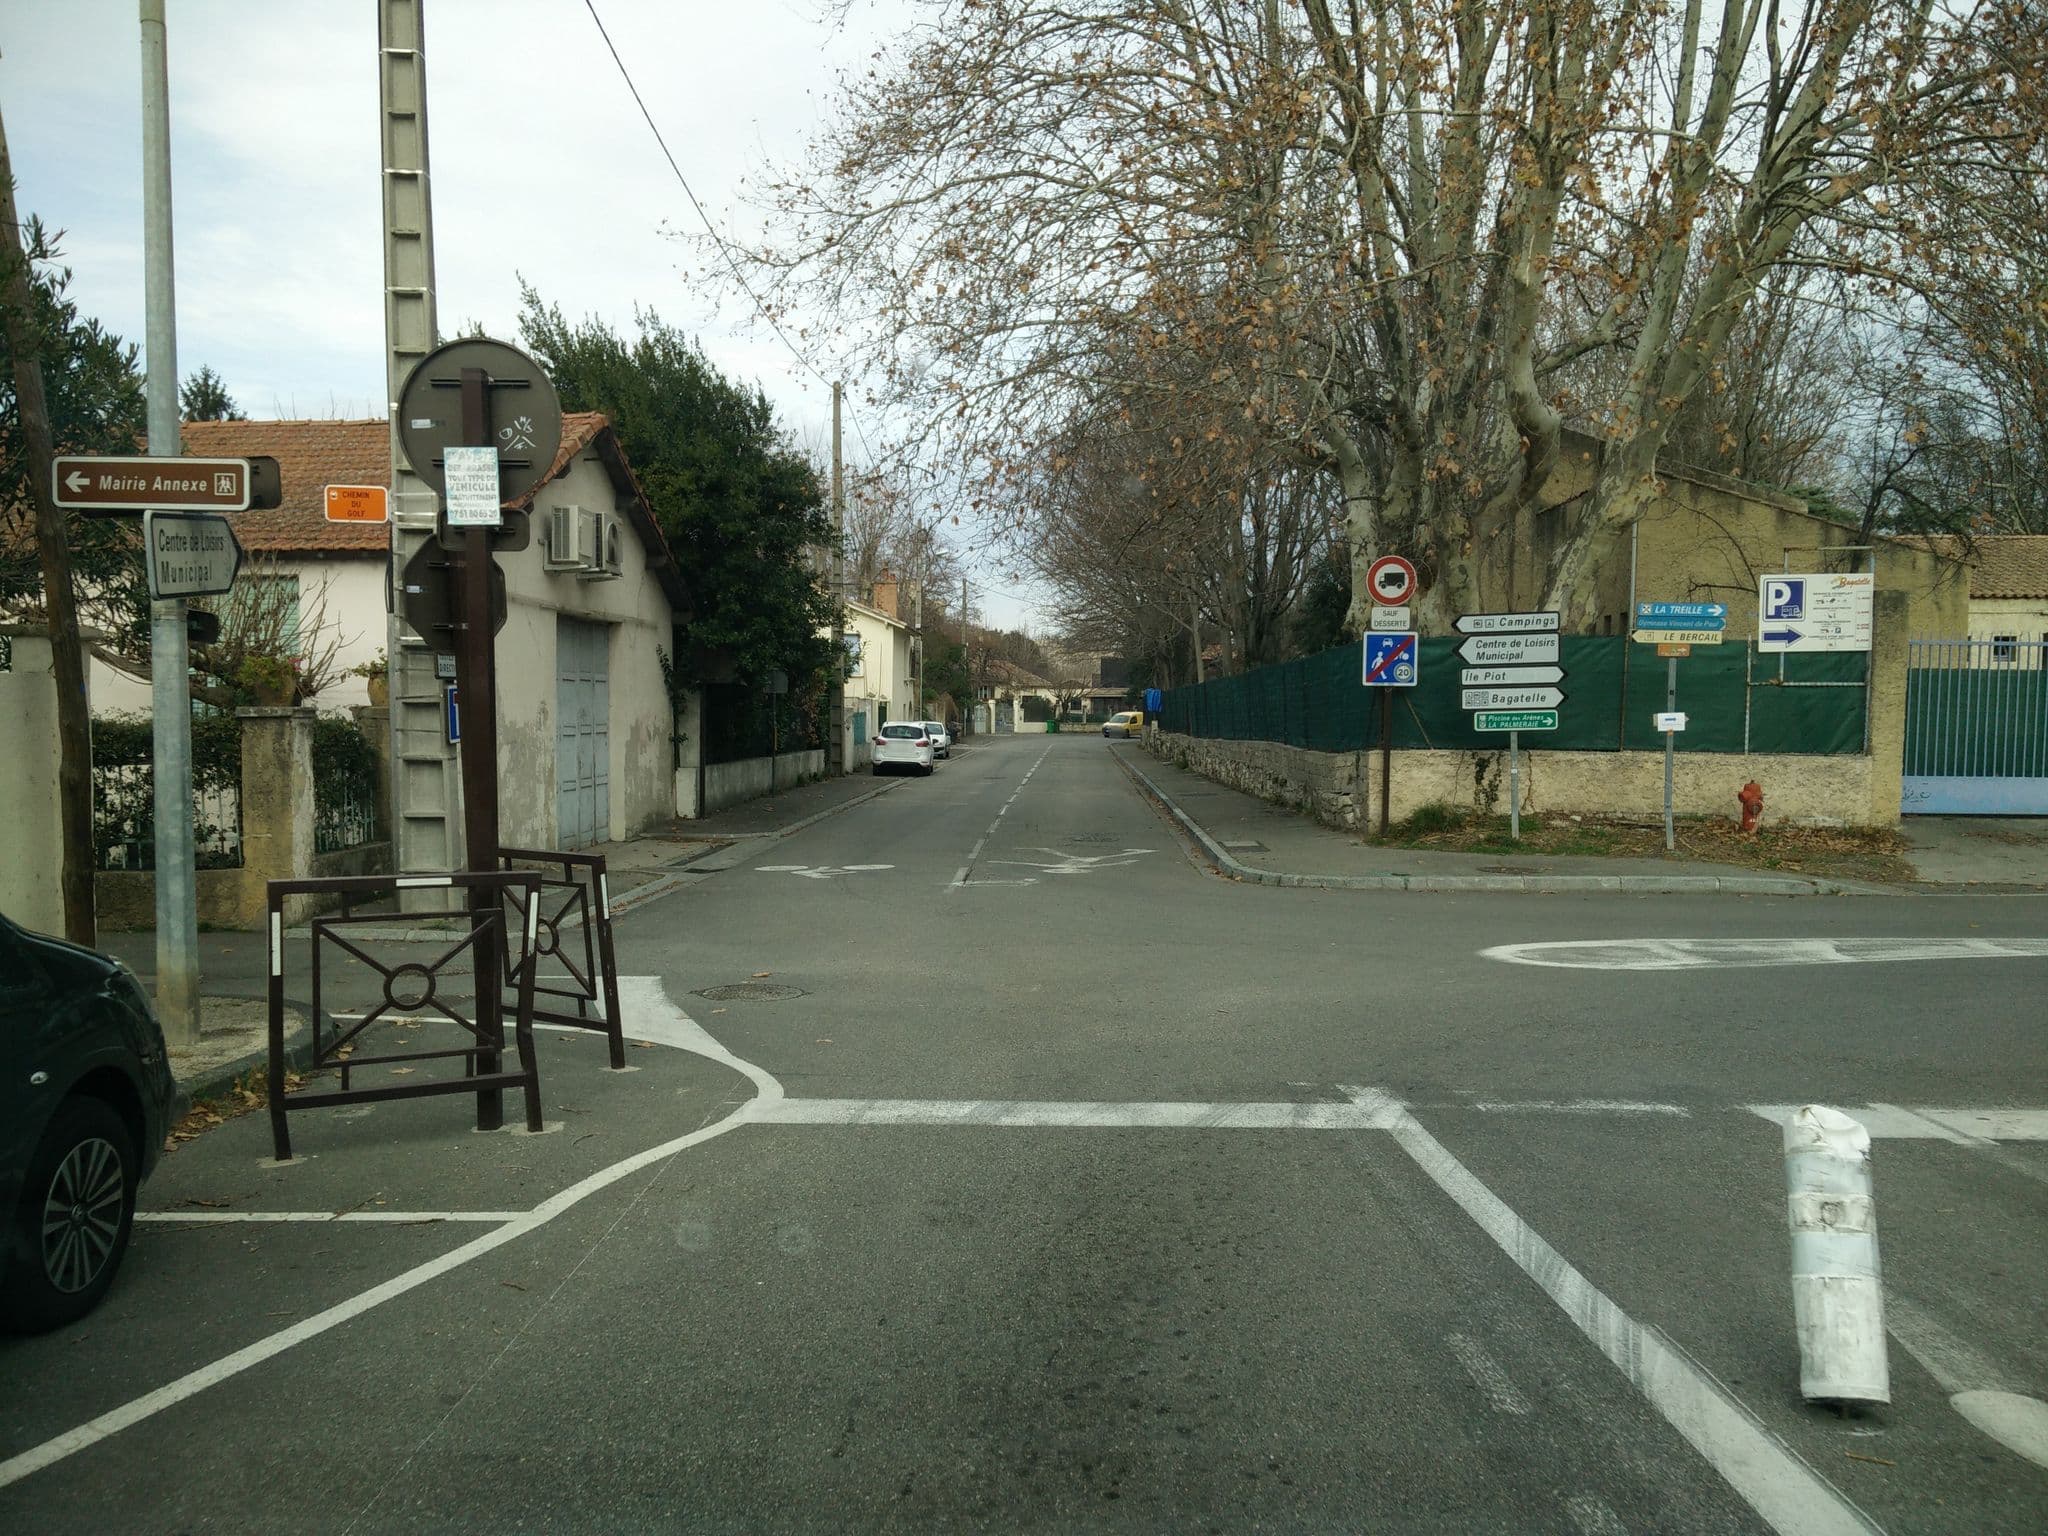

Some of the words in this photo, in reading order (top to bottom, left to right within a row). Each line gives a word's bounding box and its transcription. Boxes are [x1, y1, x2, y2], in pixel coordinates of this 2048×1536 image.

[100, 475, 146, 491] Mairie
[152, 476, 207, 492] Annexe
[342, 491, 370, 499] CHEMIN
[351, 500, 361, 508] DU
[346, 510, 366, 518] GOLF
[159, 529, 187, 551] Centre
[189, 533, 199, 551] de
[201, 533, 225, 551] Loisirs
[161, 560, 213, 584] Municipal
[1767, 582, 1792, 616] P
[1654, 606, 1666, 614] LA
[1670, 606, 1703, 614] TREILLE
[1499, 616, 1555, 628] Campings
[1664, 633, 1675, 641] LE
[1680, 633, 1719, 641] BERCAIL
[1476, 639, 1507, 649] Centre
[1510, 639, 1522, 648] de
[1525, 638, 1556, 648] Loisirs
[1476, 651, 1523, 661] Municipal
[1398, 668, 1409, 677] 20
[1465, 670, 1479, 681] Île
[1484, 672, 1506, 681] Piot
[1491, 693, 1547, 705] Bagatelle
